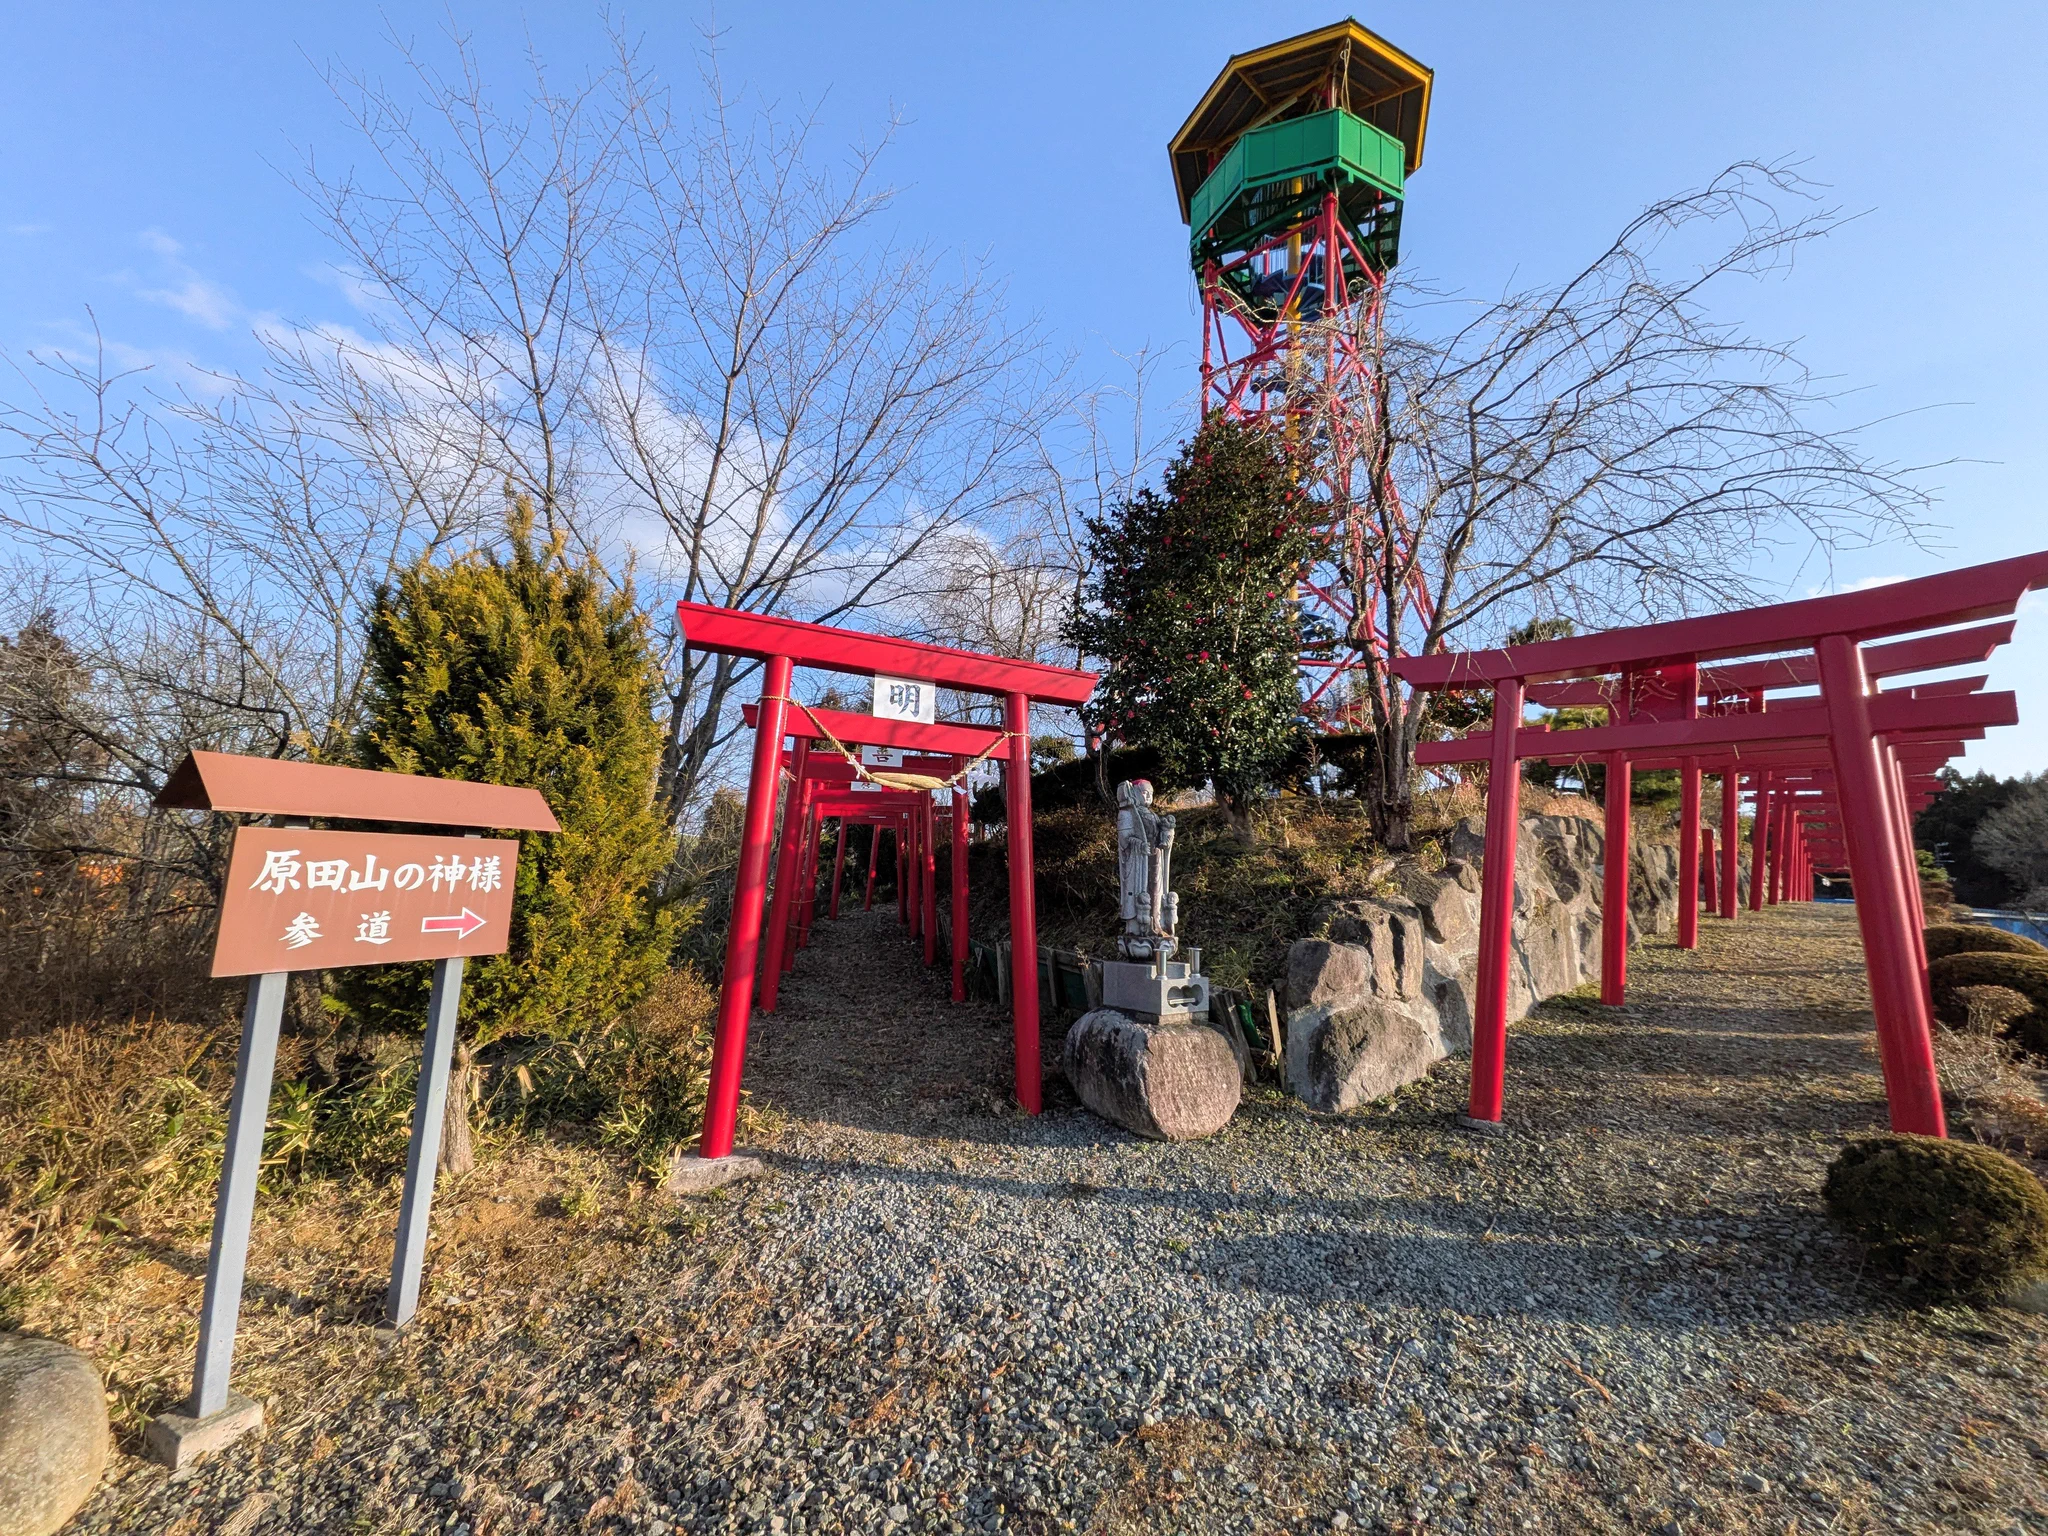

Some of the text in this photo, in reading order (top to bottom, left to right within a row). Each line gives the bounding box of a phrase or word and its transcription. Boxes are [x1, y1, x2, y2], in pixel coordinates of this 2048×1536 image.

[889, 683, 921, 718] 明
[249, 849, 502, 895] 原田山の神様
